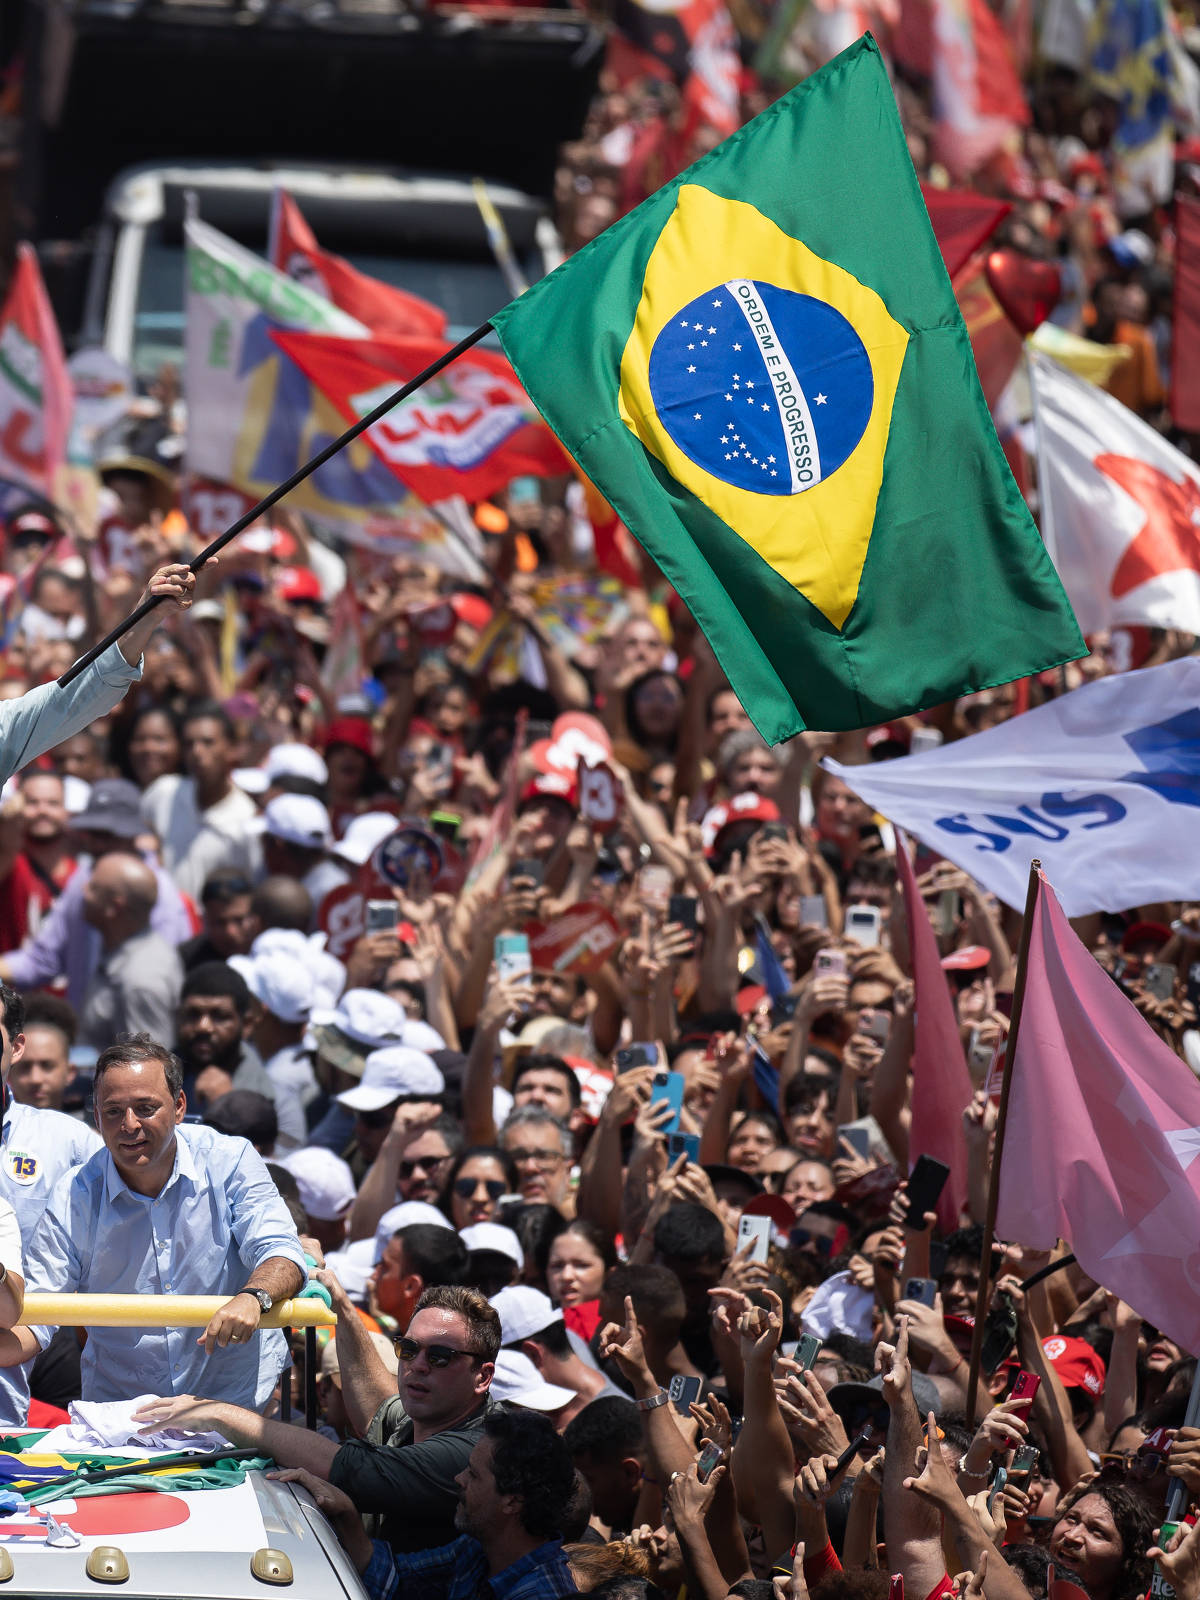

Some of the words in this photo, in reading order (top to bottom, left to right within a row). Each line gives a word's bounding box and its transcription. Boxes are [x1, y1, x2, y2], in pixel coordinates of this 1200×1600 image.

[737, 284, 775, 351] ORDEM
[766, 354, 782, 368] E
[772, 370, 814, 484] PROGRESSO
[934, 792, 1128, 853] SUS
[13, 1156, 37, 1176] 13
